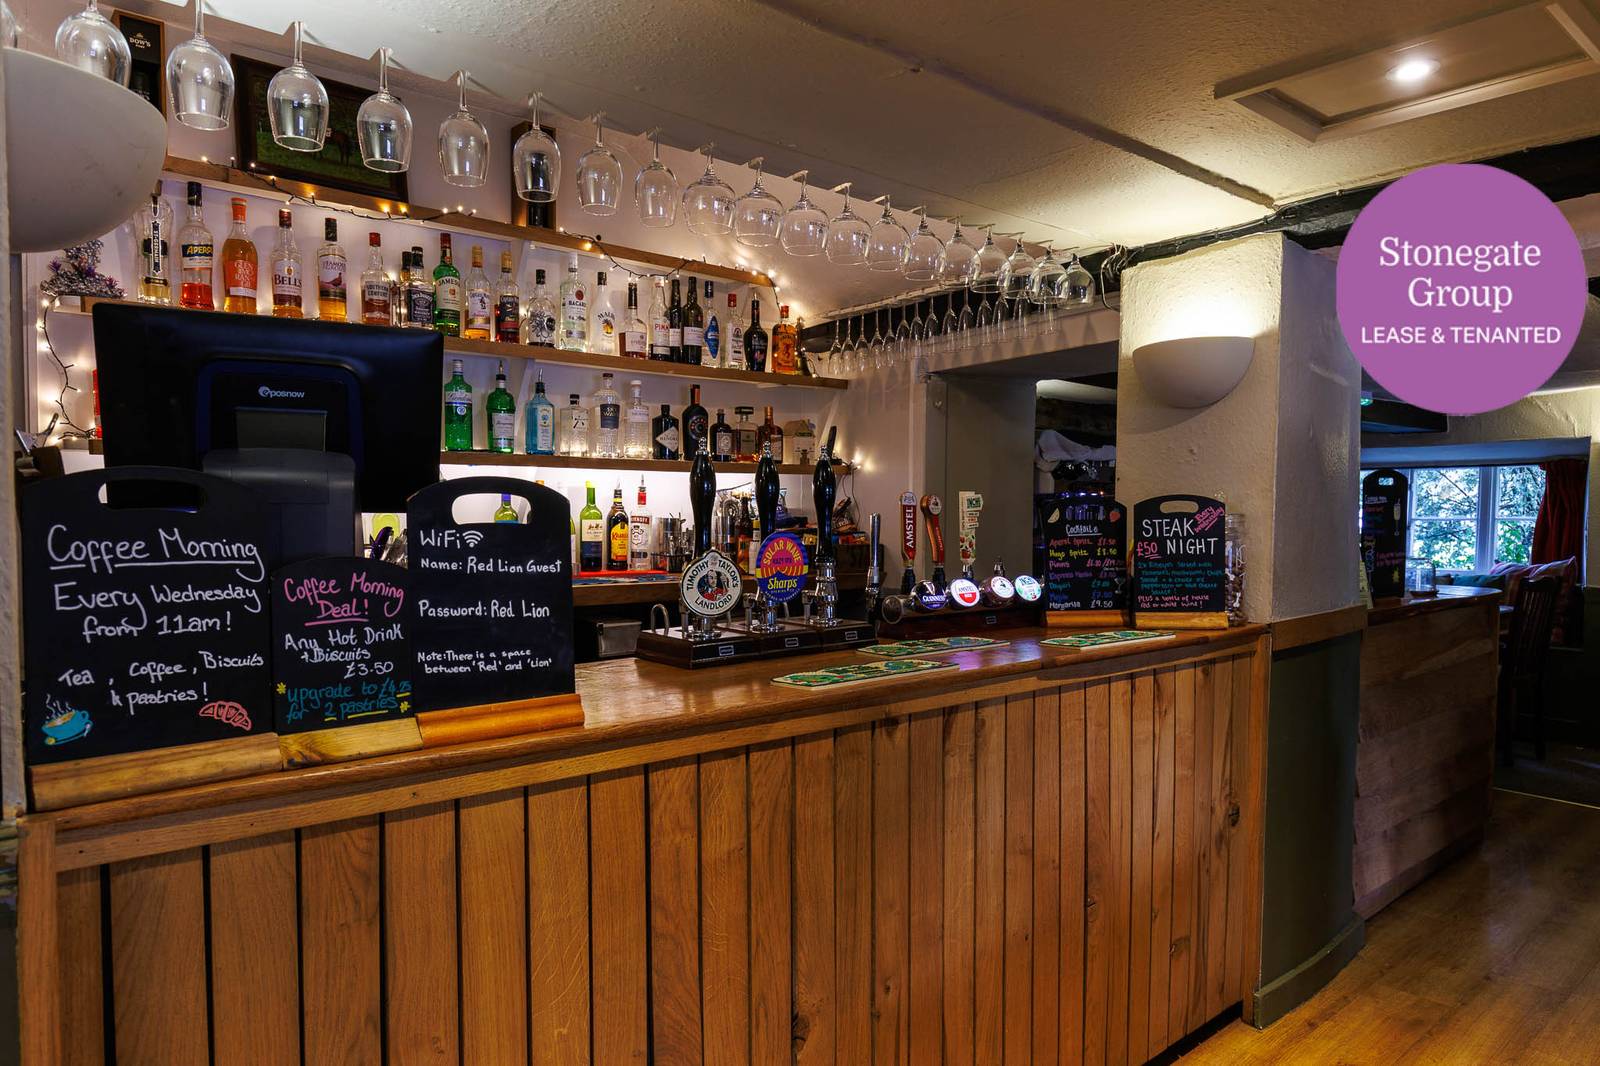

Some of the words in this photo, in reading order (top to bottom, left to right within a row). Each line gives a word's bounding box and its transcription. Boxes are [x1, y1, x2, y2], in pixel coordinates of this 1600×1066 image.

[905, 506, 914, 548] AMSTEL
[1142, 518, 1194, 538] STEAK
[420, 530, 460, 548] WiFi
[1136, 542, 1158, 556] £50
[1166, 538, 1218, 555] NIGHT
[47, 524, 150, 574] Coffee
[158, 528, 265, 582] Morning
[763, 540, 784, 566] SOLAR
[786, 540, 802, 562] WAVE
[420, 558, 462, 570] Name:
[466, 556, 494, 574] Red
[498, 558, 523, 573] Lion
[526, 560, 562, 572] Guest
[687, 560, 710, 591] TIMOTHY
[718, 559, 738, 588] TAYLOR'S
[284, 576, 342, 606] Coffee
[350, 572, 404, 617] Morning
[694, 593, 732, 610] LANDLORD
[54, 582, 148, 630] Every
[150, 584, 262, 613] Wednesday
[316, 598, 368, 618] Deal!
[418, 600, 487, 618] Password:
[490, 600, 515, 618] Red
[522, 600, 550, 618] Lion
[82, 617, 140, 644] from
[156, 612, 232, 634] 11am!
[284, 634, 318, 651] Any
[328, 628, 358, 646] Hot
[199, 650, 264, 670] Biscuits
[310, 648, 371, 663] Biscuits
[476, 650, 484, 659] is
[502, 650, 532, 659] space
[344, 662, 394, 679] £3.50
[424, 664, 471, 674] between
[505, 661, 522, 671] and
[362, 681, 377, 694] to
[286, 704, 310, 724] for
[324, 702, 336, 717] 2
[340, 698, 398, 720] pastries
